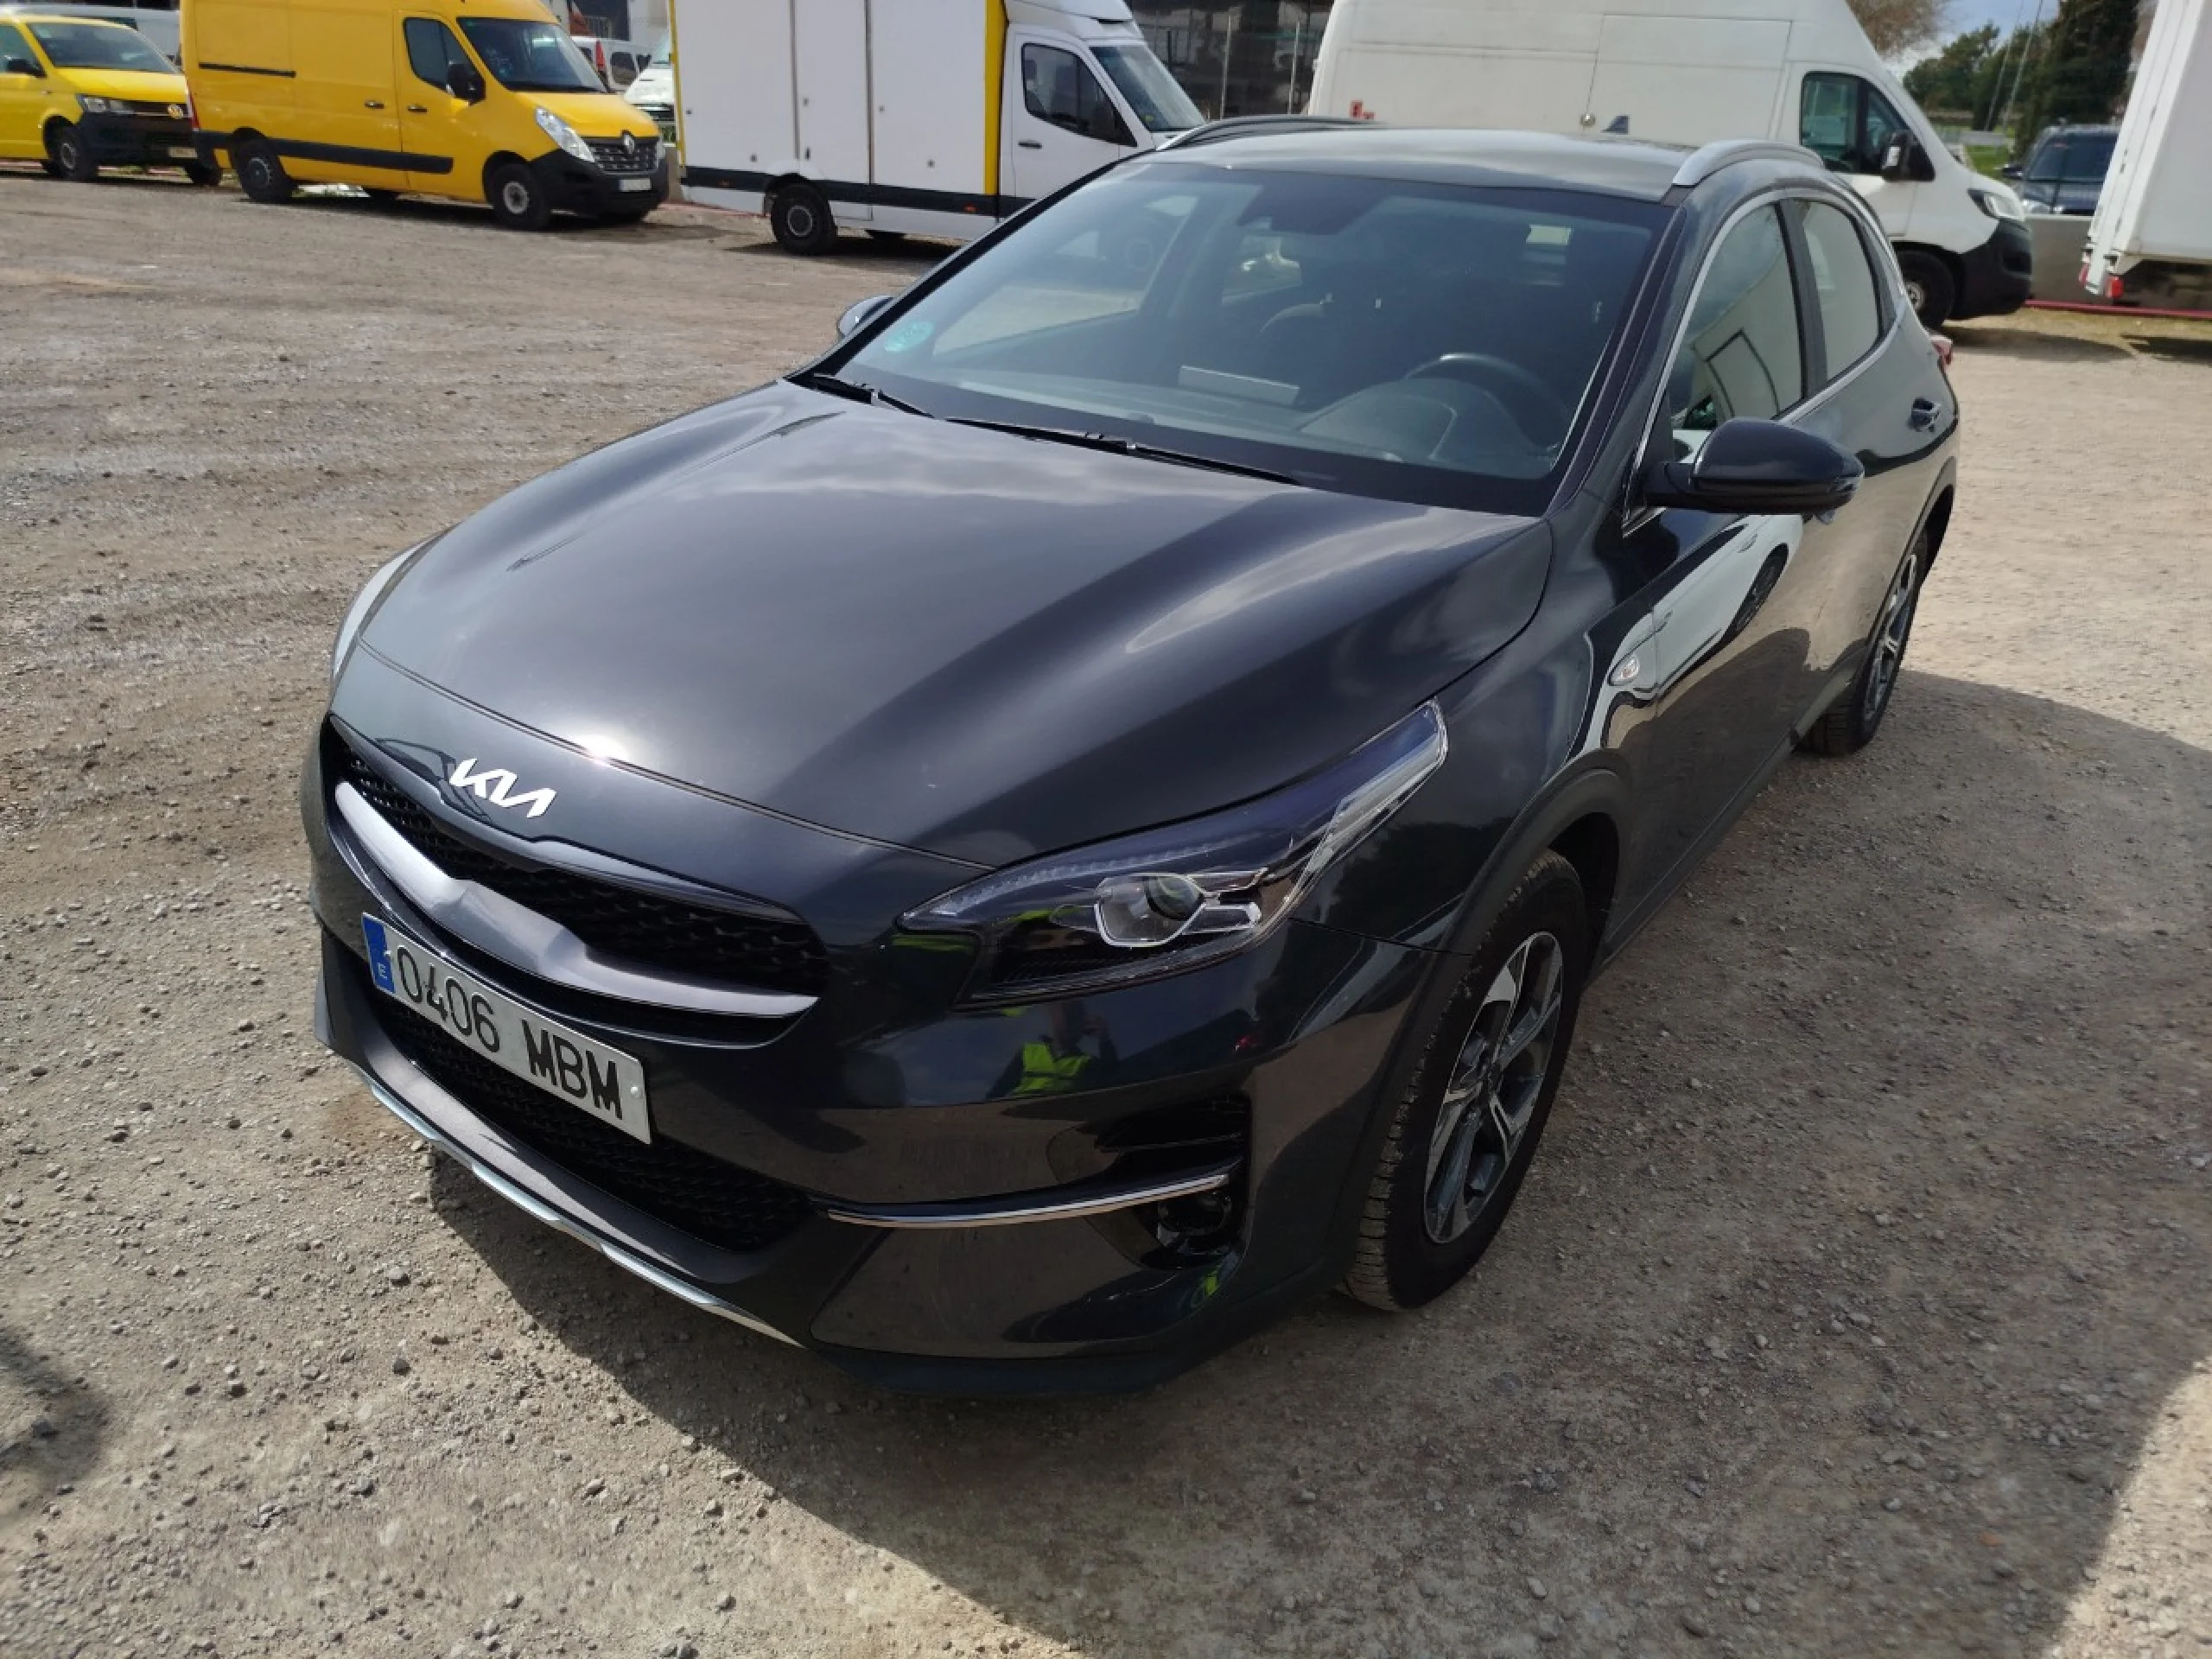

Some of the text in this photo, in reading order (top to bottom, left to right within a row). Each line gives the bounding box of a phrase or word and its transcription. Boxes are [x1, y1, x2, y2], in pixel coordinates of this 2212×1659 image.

[449, 758, 557, 818] KIA
[377, 962, 388, 980] E
[397, 944, 623, 1121] 0406 MBM
